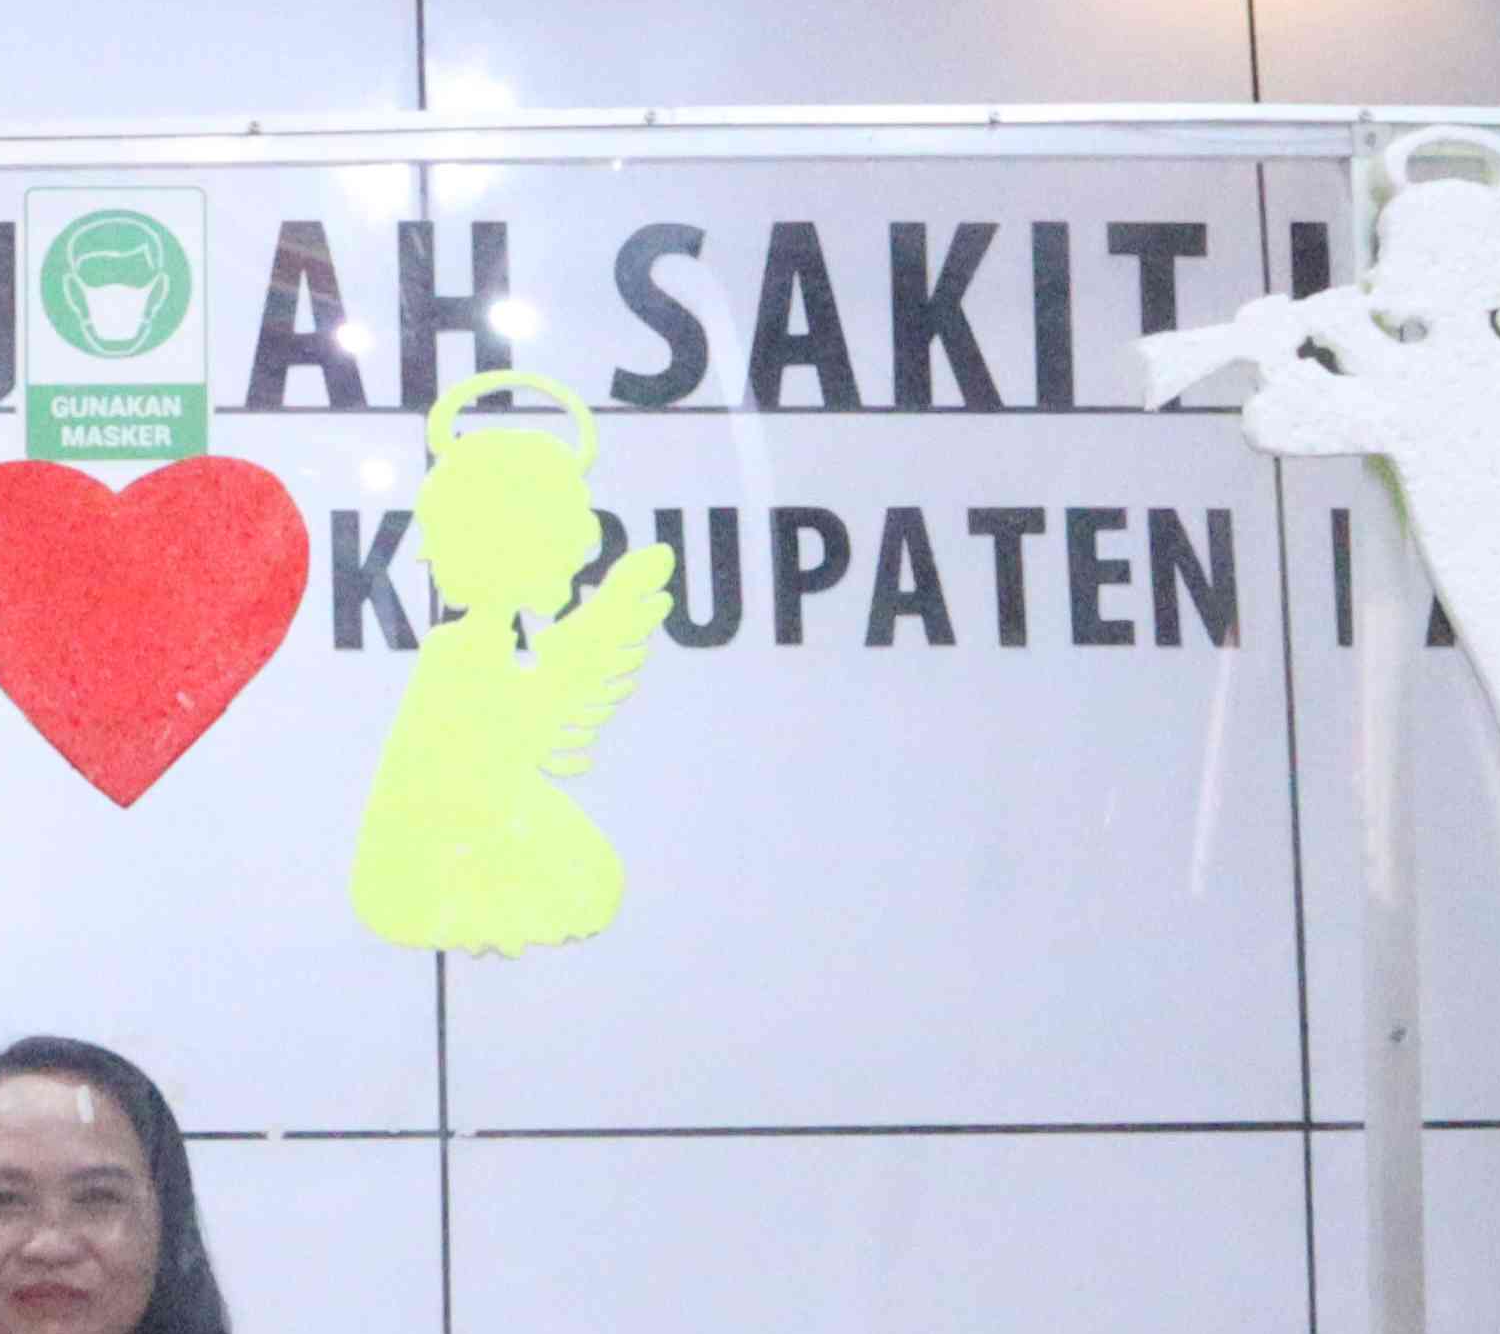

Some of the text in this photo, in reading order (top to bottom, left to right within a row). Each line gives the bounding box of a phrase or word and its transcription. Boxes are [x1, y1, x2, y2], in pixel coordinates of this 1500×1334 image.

[609, 221, 1207, 411] SAKIT
[51, 395, 183, 418] GUNAKAN
[61, 424, 173, 448] MASKER
